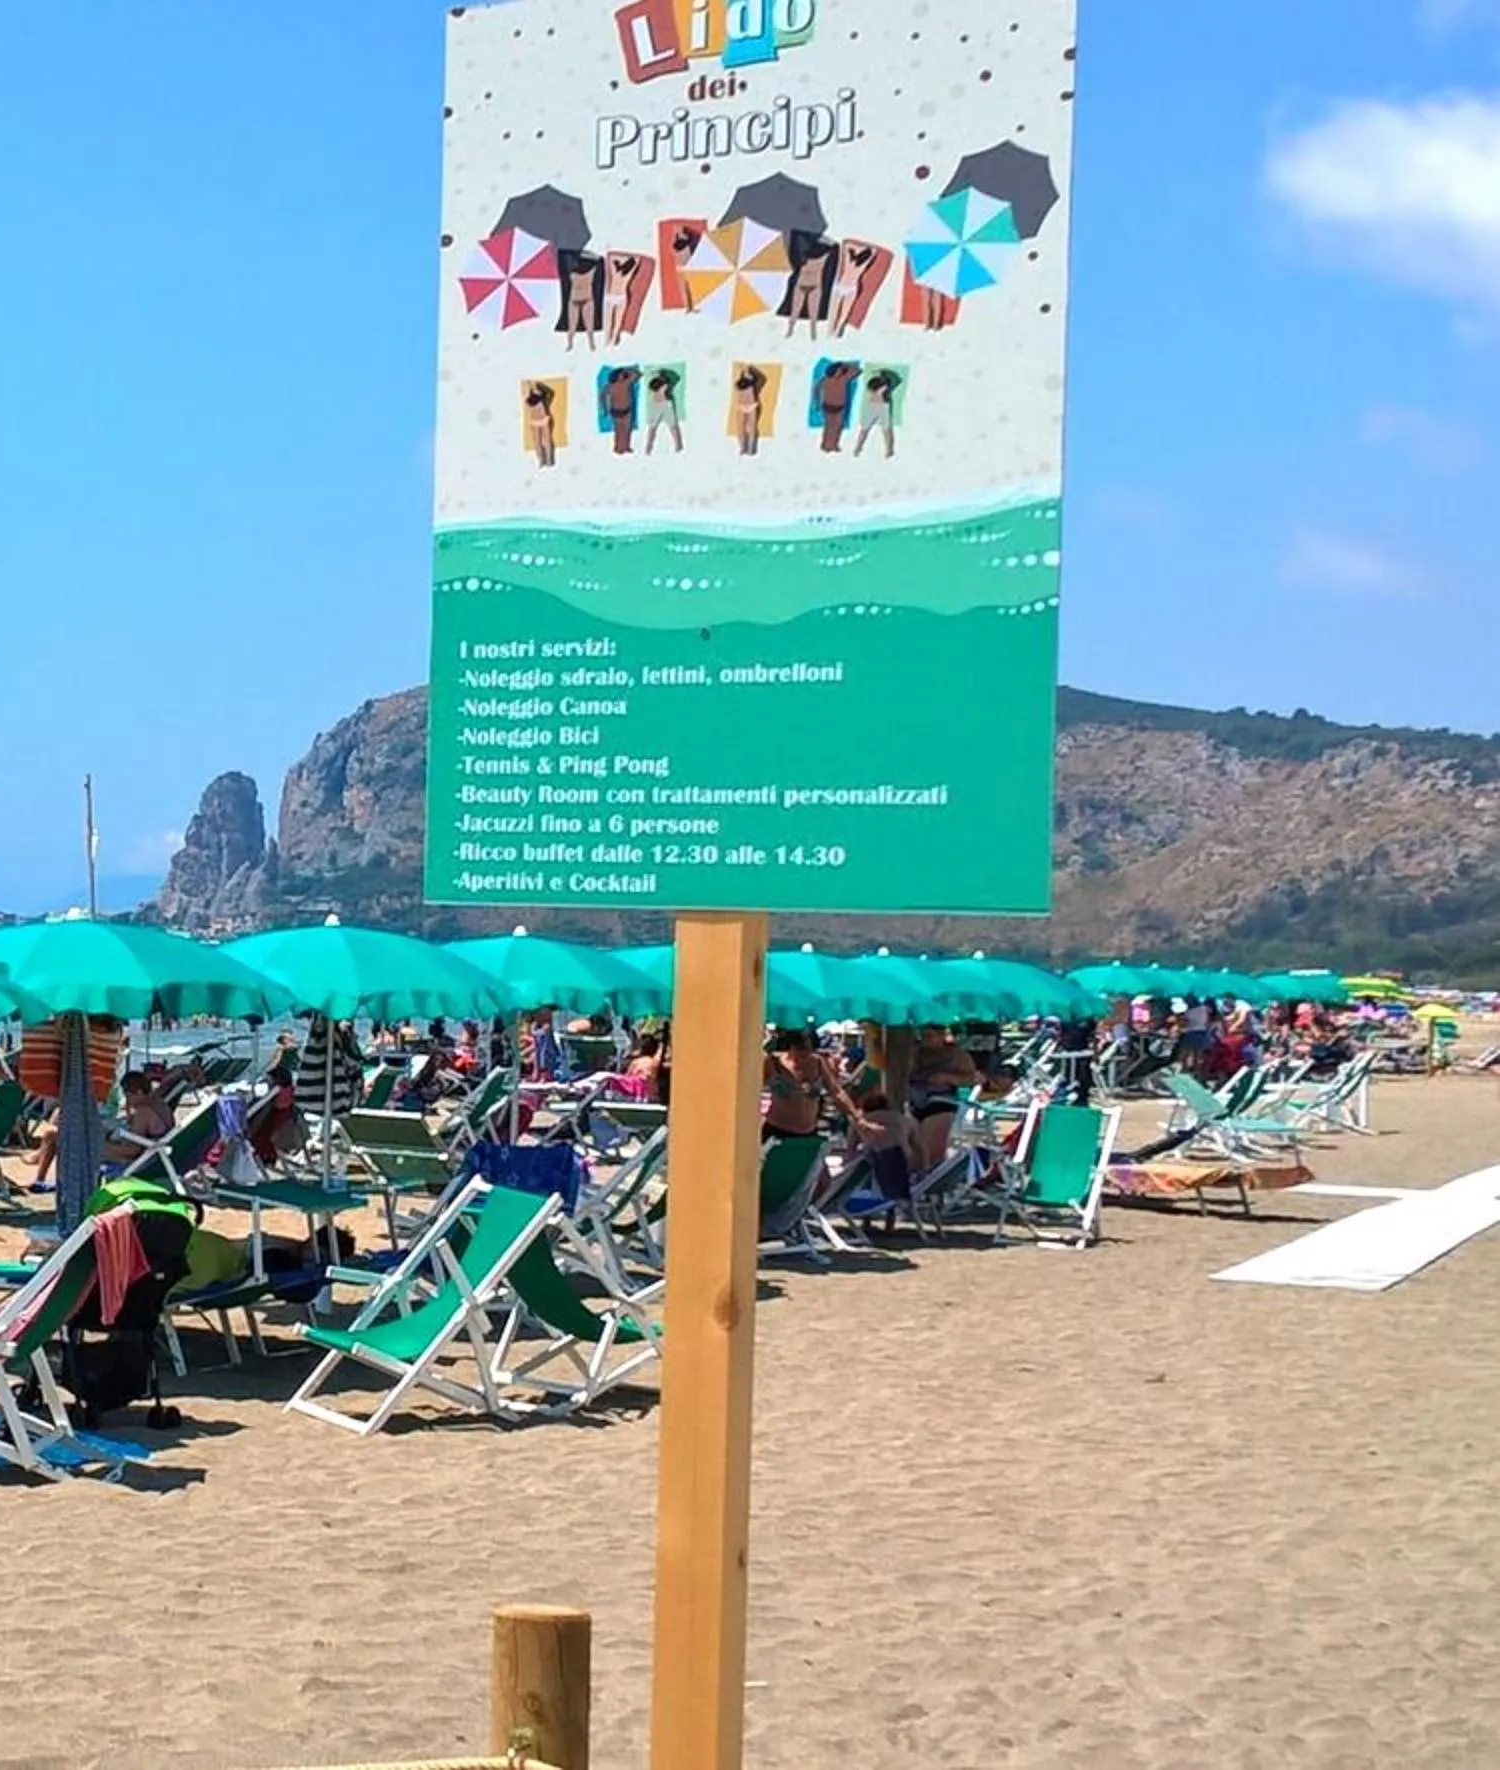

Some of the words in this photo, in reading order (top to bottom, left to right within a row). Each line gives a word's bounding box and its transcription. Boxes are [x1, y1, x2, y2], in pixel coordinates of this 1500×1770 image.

[630, 0, 816, 68] Lido
[688, 72, 736, 102] dei
[595, 89, 857, 170] Principi
[460, 641, 467, 658] I
[474, 640, 535, 659] nostri
[542, 638, 616, 657] servizi:
[458, 669, 554, 690] -Noleggio
[561, 667, 633, 686] sdraio,
[642, 666, 711, 684] lettini,
[720, 663, 843, 683] ombrelloni
[457, 699, 553, 719] -Noleggio
[559, 698, 626, 717] Canoa
[457, 728, 553, 748] -Noleggio
[559, 727, 599, 745] Bici
[457, 756, 530, 773] -Tennis
[536, 757, 551, 773] &
[559, 756, 607, 777] Ping
[614, 756, 669, 777] Pong
[456, 785, 530, 805] -Beauty
[538, 785, 599, 803] Room
[607, 788, 645, 803] con
[652, 786, 777, 804] trattamenti
[784, 785, 947, 808] personalizzati
[455, 814, 533, 833] -Jacuzzi
[541, 815, 582, 833] fino
[588, 819, 601, 833] a
[609, 815, 623, 833] 6
[631, 818, 719, 837] persone
[454, 843, 516, 861] -Ricco
[522, 844, 583, 862] buffet
[591, 844, 643, 863] dalle
[653, 846, 719, 864] 12.30
[725, 846, 766, 864] alle
[777, 847, 846, 865] 14.30
[453, 872, 543, 892] -Aperitivi
[549, 877, 562, 891] e
[569, 874, 656, 893] Cocktail
